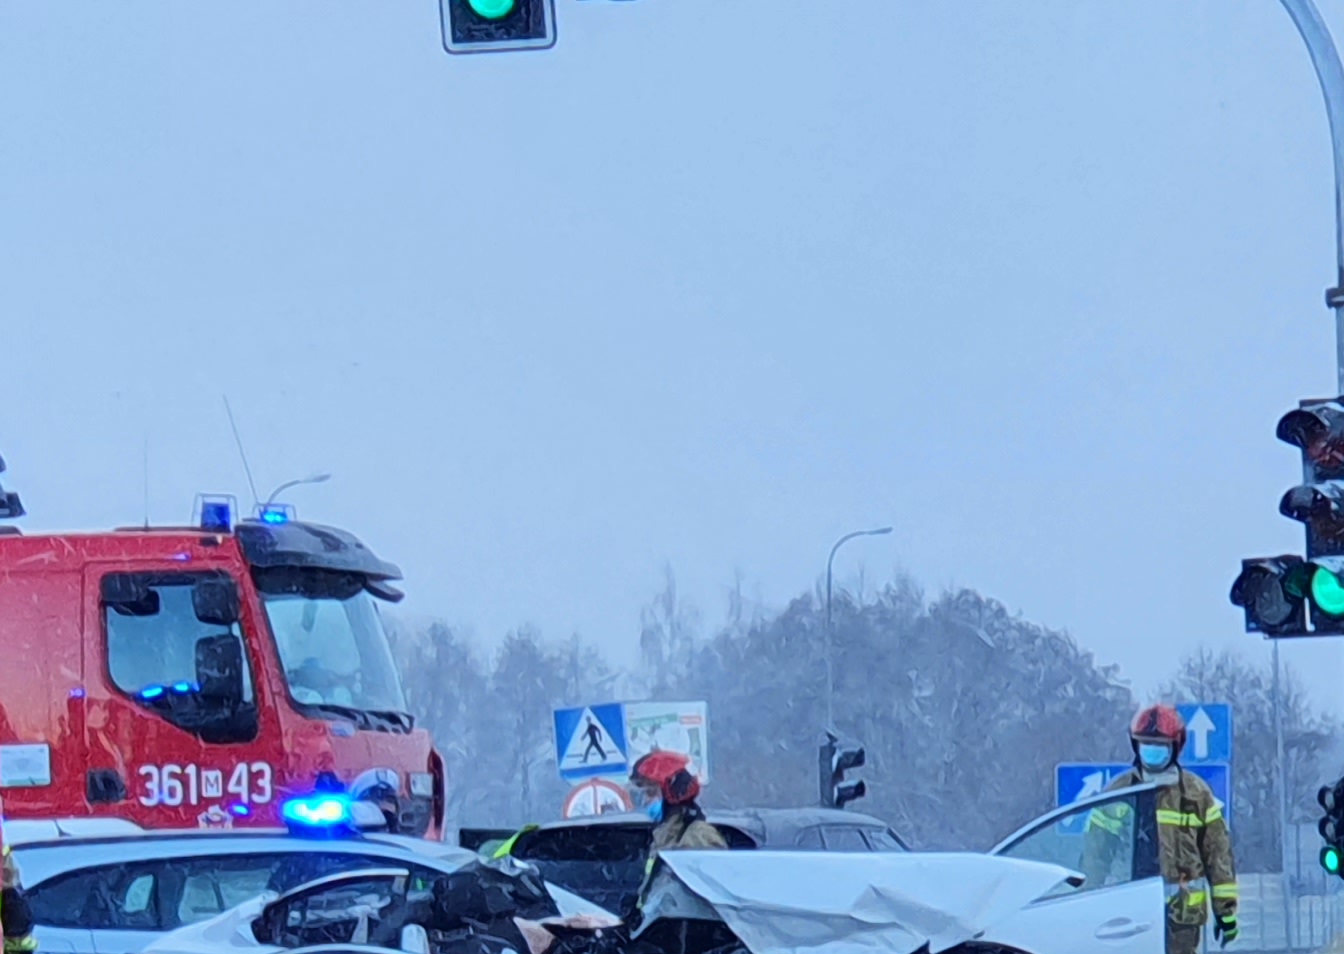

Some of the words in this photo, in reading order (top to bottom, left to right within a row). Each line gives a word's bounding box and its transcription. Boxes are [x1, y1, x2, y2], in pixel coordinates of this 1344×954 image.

[138, 763, 198, 806] 361
[203, 771, 221, 796] M
[227, 761, 272, 804] 43
